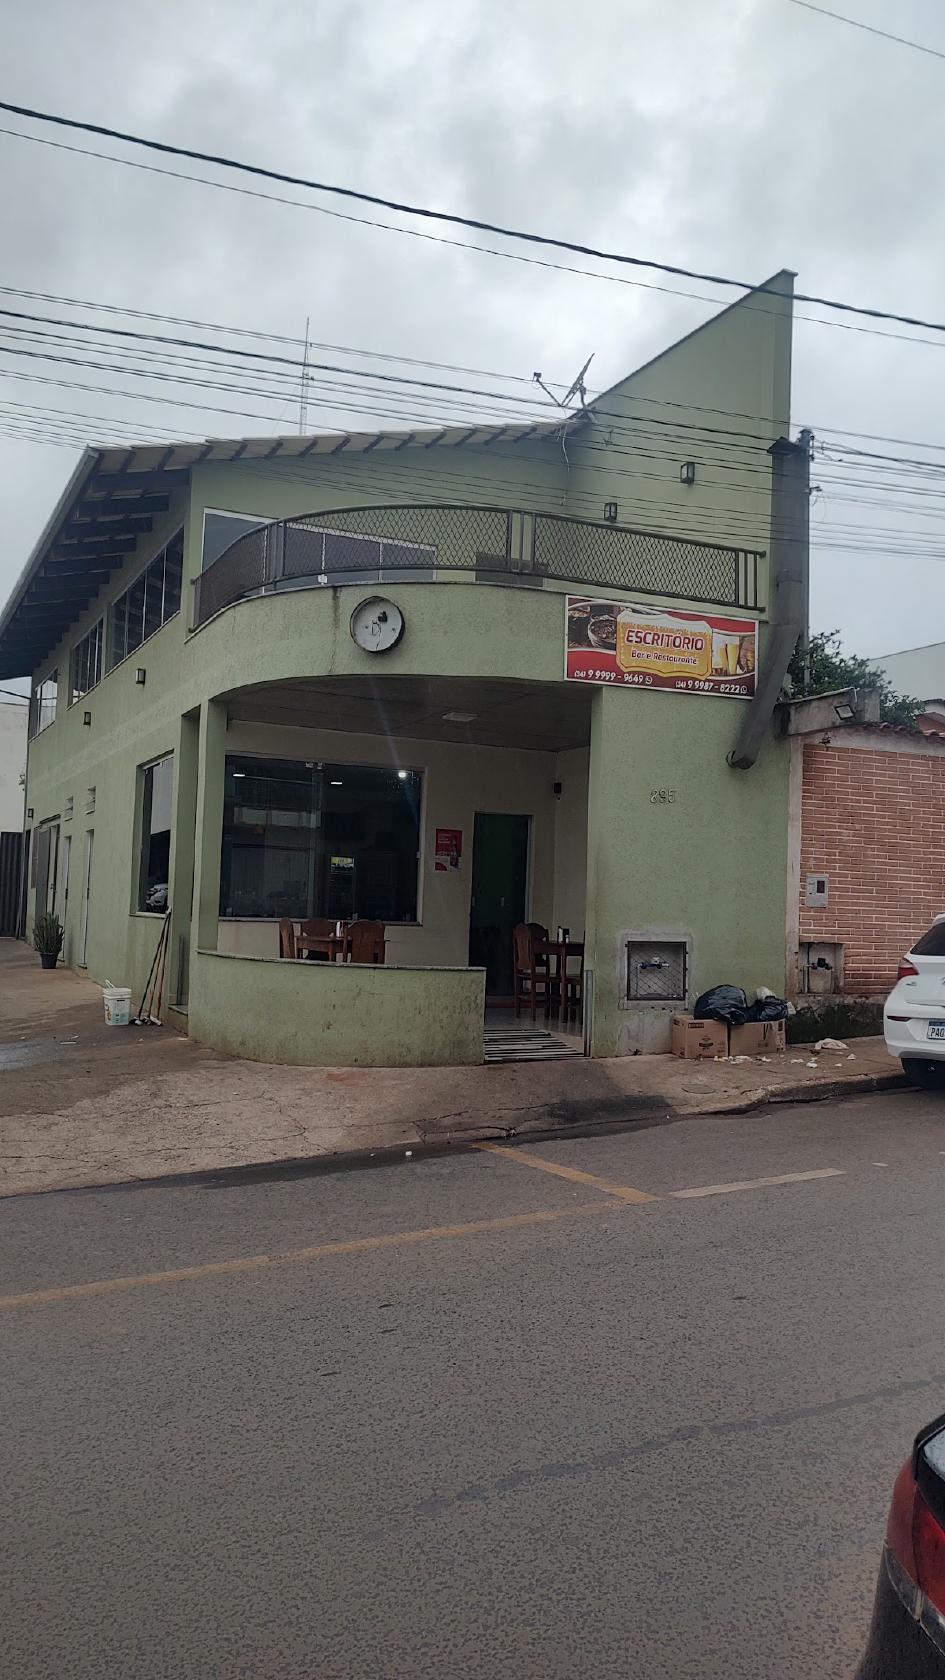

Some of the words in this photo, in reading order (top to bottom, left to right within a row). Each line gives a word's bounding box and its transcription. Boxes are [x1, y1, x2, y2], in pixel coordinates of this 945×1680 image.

[631, 649, 645, 660] Bar
[646, 652, 652, 660] e
[653, 652, 698, 665] Restaurante
[588, 669, 594, 679] 9
[595, 670, 617, 681] 9999
[623, 673, 645, 684] 9649
[687, 679, 694, 689] 9
[694, 680, 714, 691] 9987
